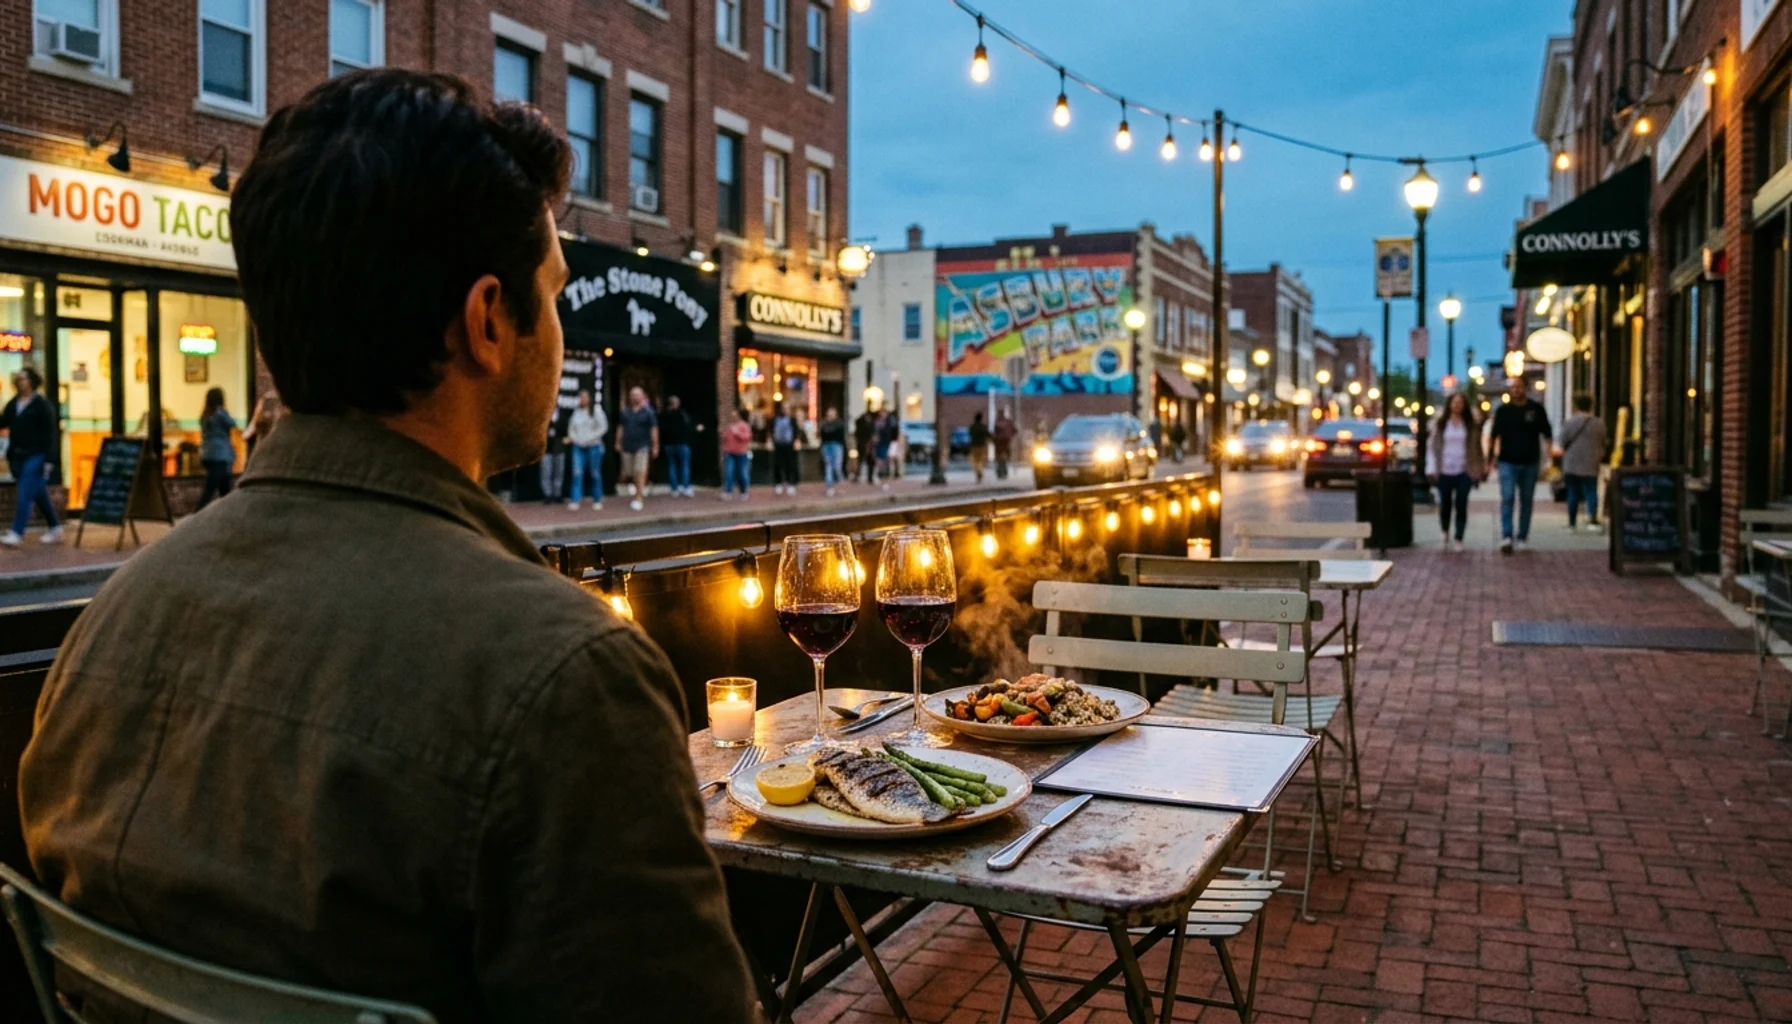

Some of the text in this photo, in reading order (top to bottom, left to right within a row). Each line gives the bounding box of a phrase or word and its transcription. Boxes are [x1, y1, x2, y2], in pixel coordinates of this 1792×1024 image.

[29, 173, 140, 229] MOGO
[1522, 230, 1640, 252] CONNOLLY'S
[565, 266, 709, 330] The Stone Pony
[750, 294, 842, 333] CONNOLLY'S
[949, 268, 1126, 366] ASBURY
[1022, 305, 1128, 366] PARK
